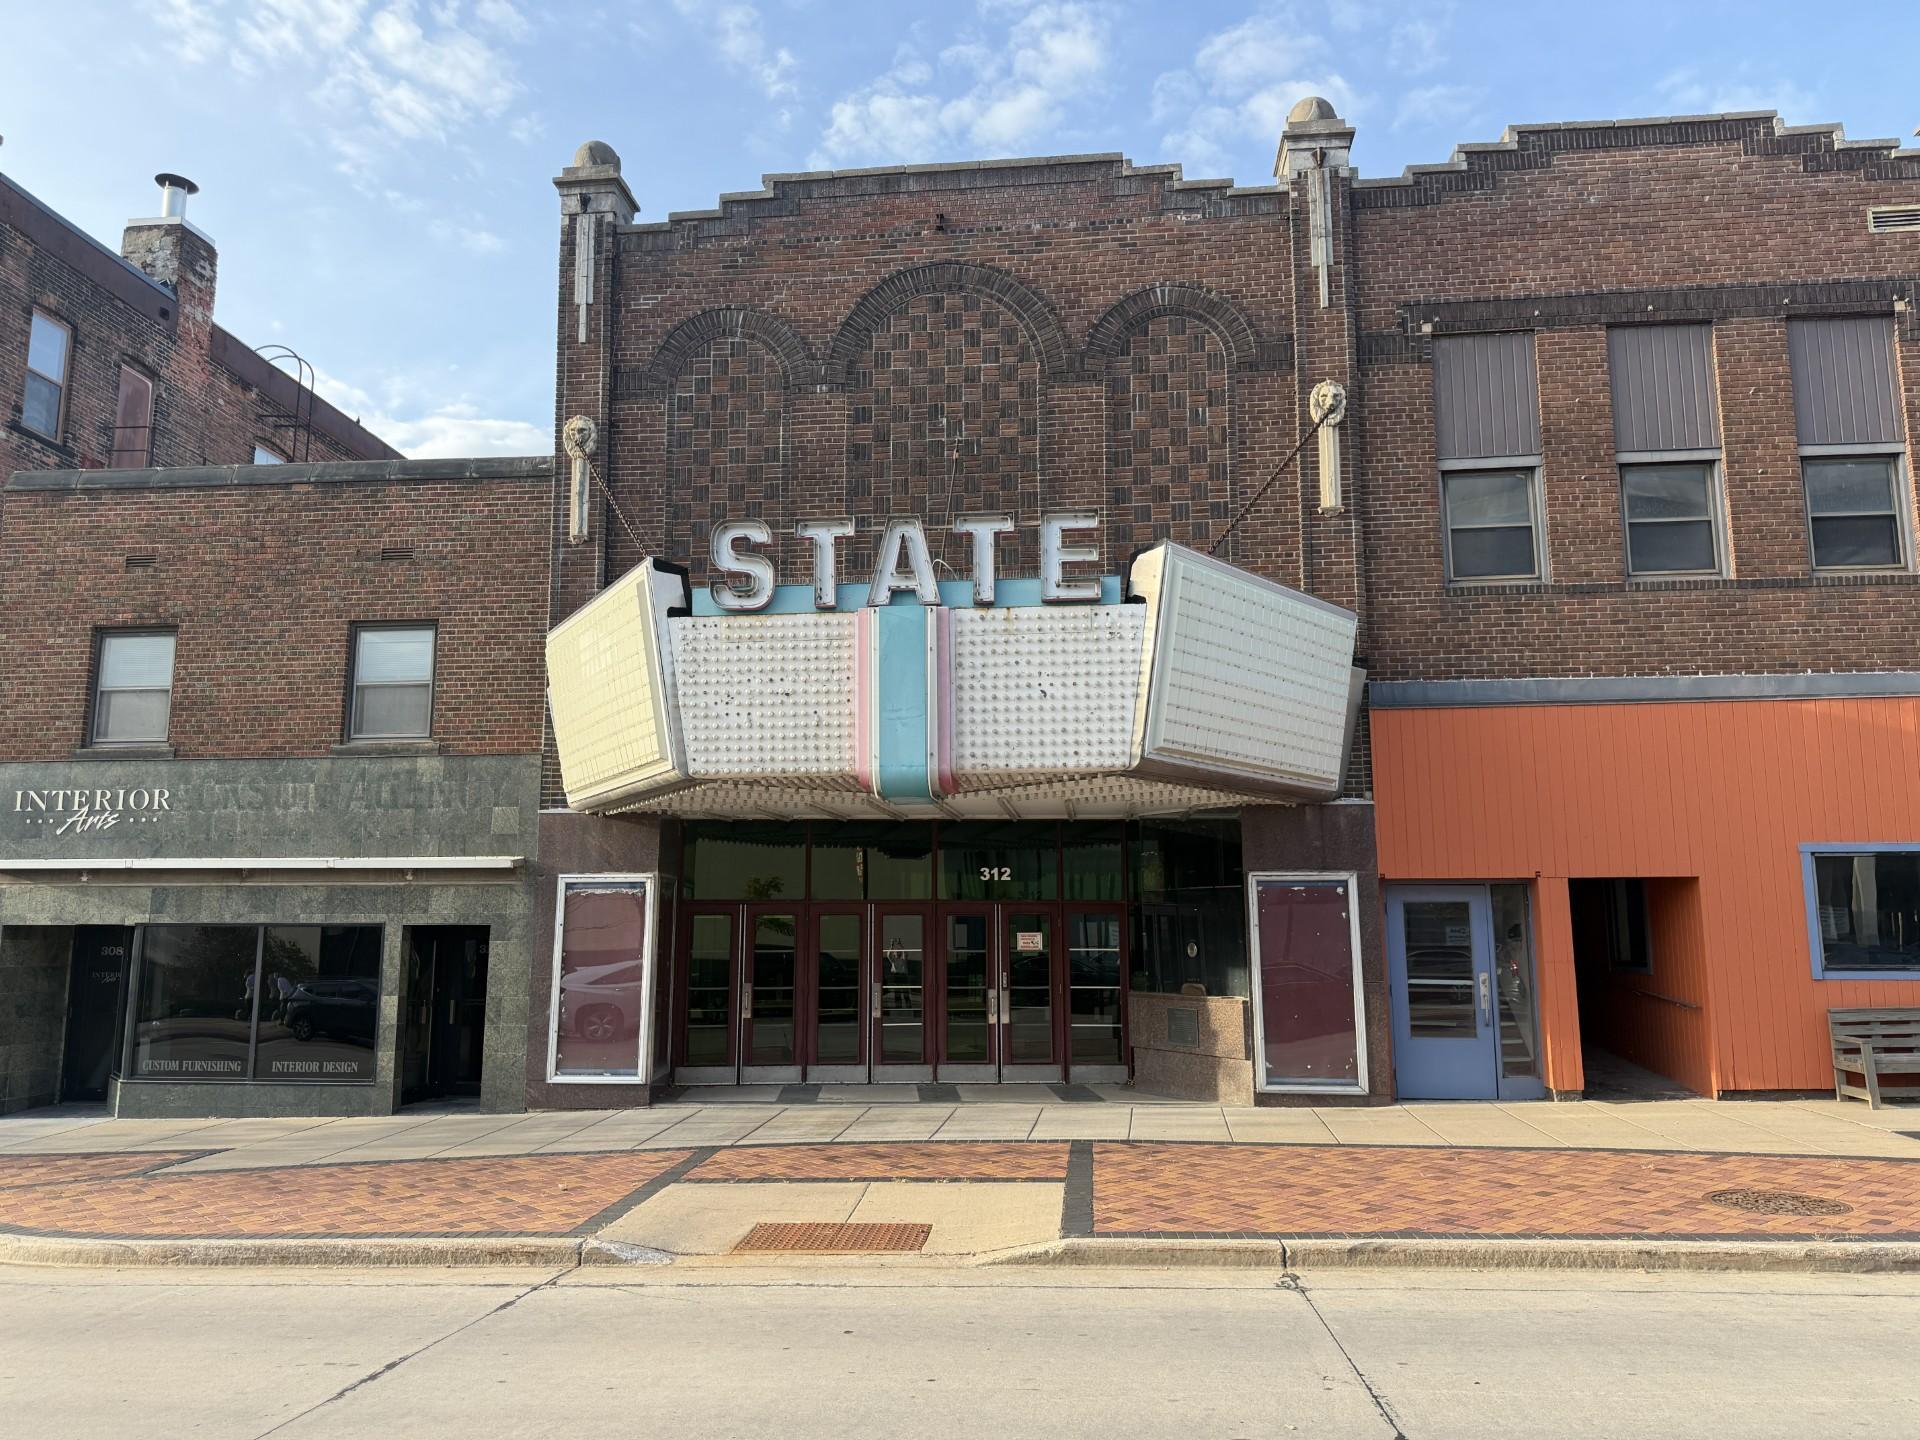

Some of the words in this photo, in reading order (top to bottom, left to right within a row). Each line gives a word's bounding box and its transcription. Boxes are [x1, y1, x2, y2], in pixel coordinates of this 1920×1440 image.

[709, 509, 1102, 611] STATE
[13, 788, 171, 812] INTERIOR
[55, 803, 121, 836] Arts
[979, 867, 1012, 881] 312
[101, 946, 124, 956] 308
[142, 1060, 180, 1072] CUSTOM
[182, 1060, 242, 1073] FURNISHING
[272, 1061, 320, 1073] INTERIOR
[323, 1061, 359, 1073] DESIGN
